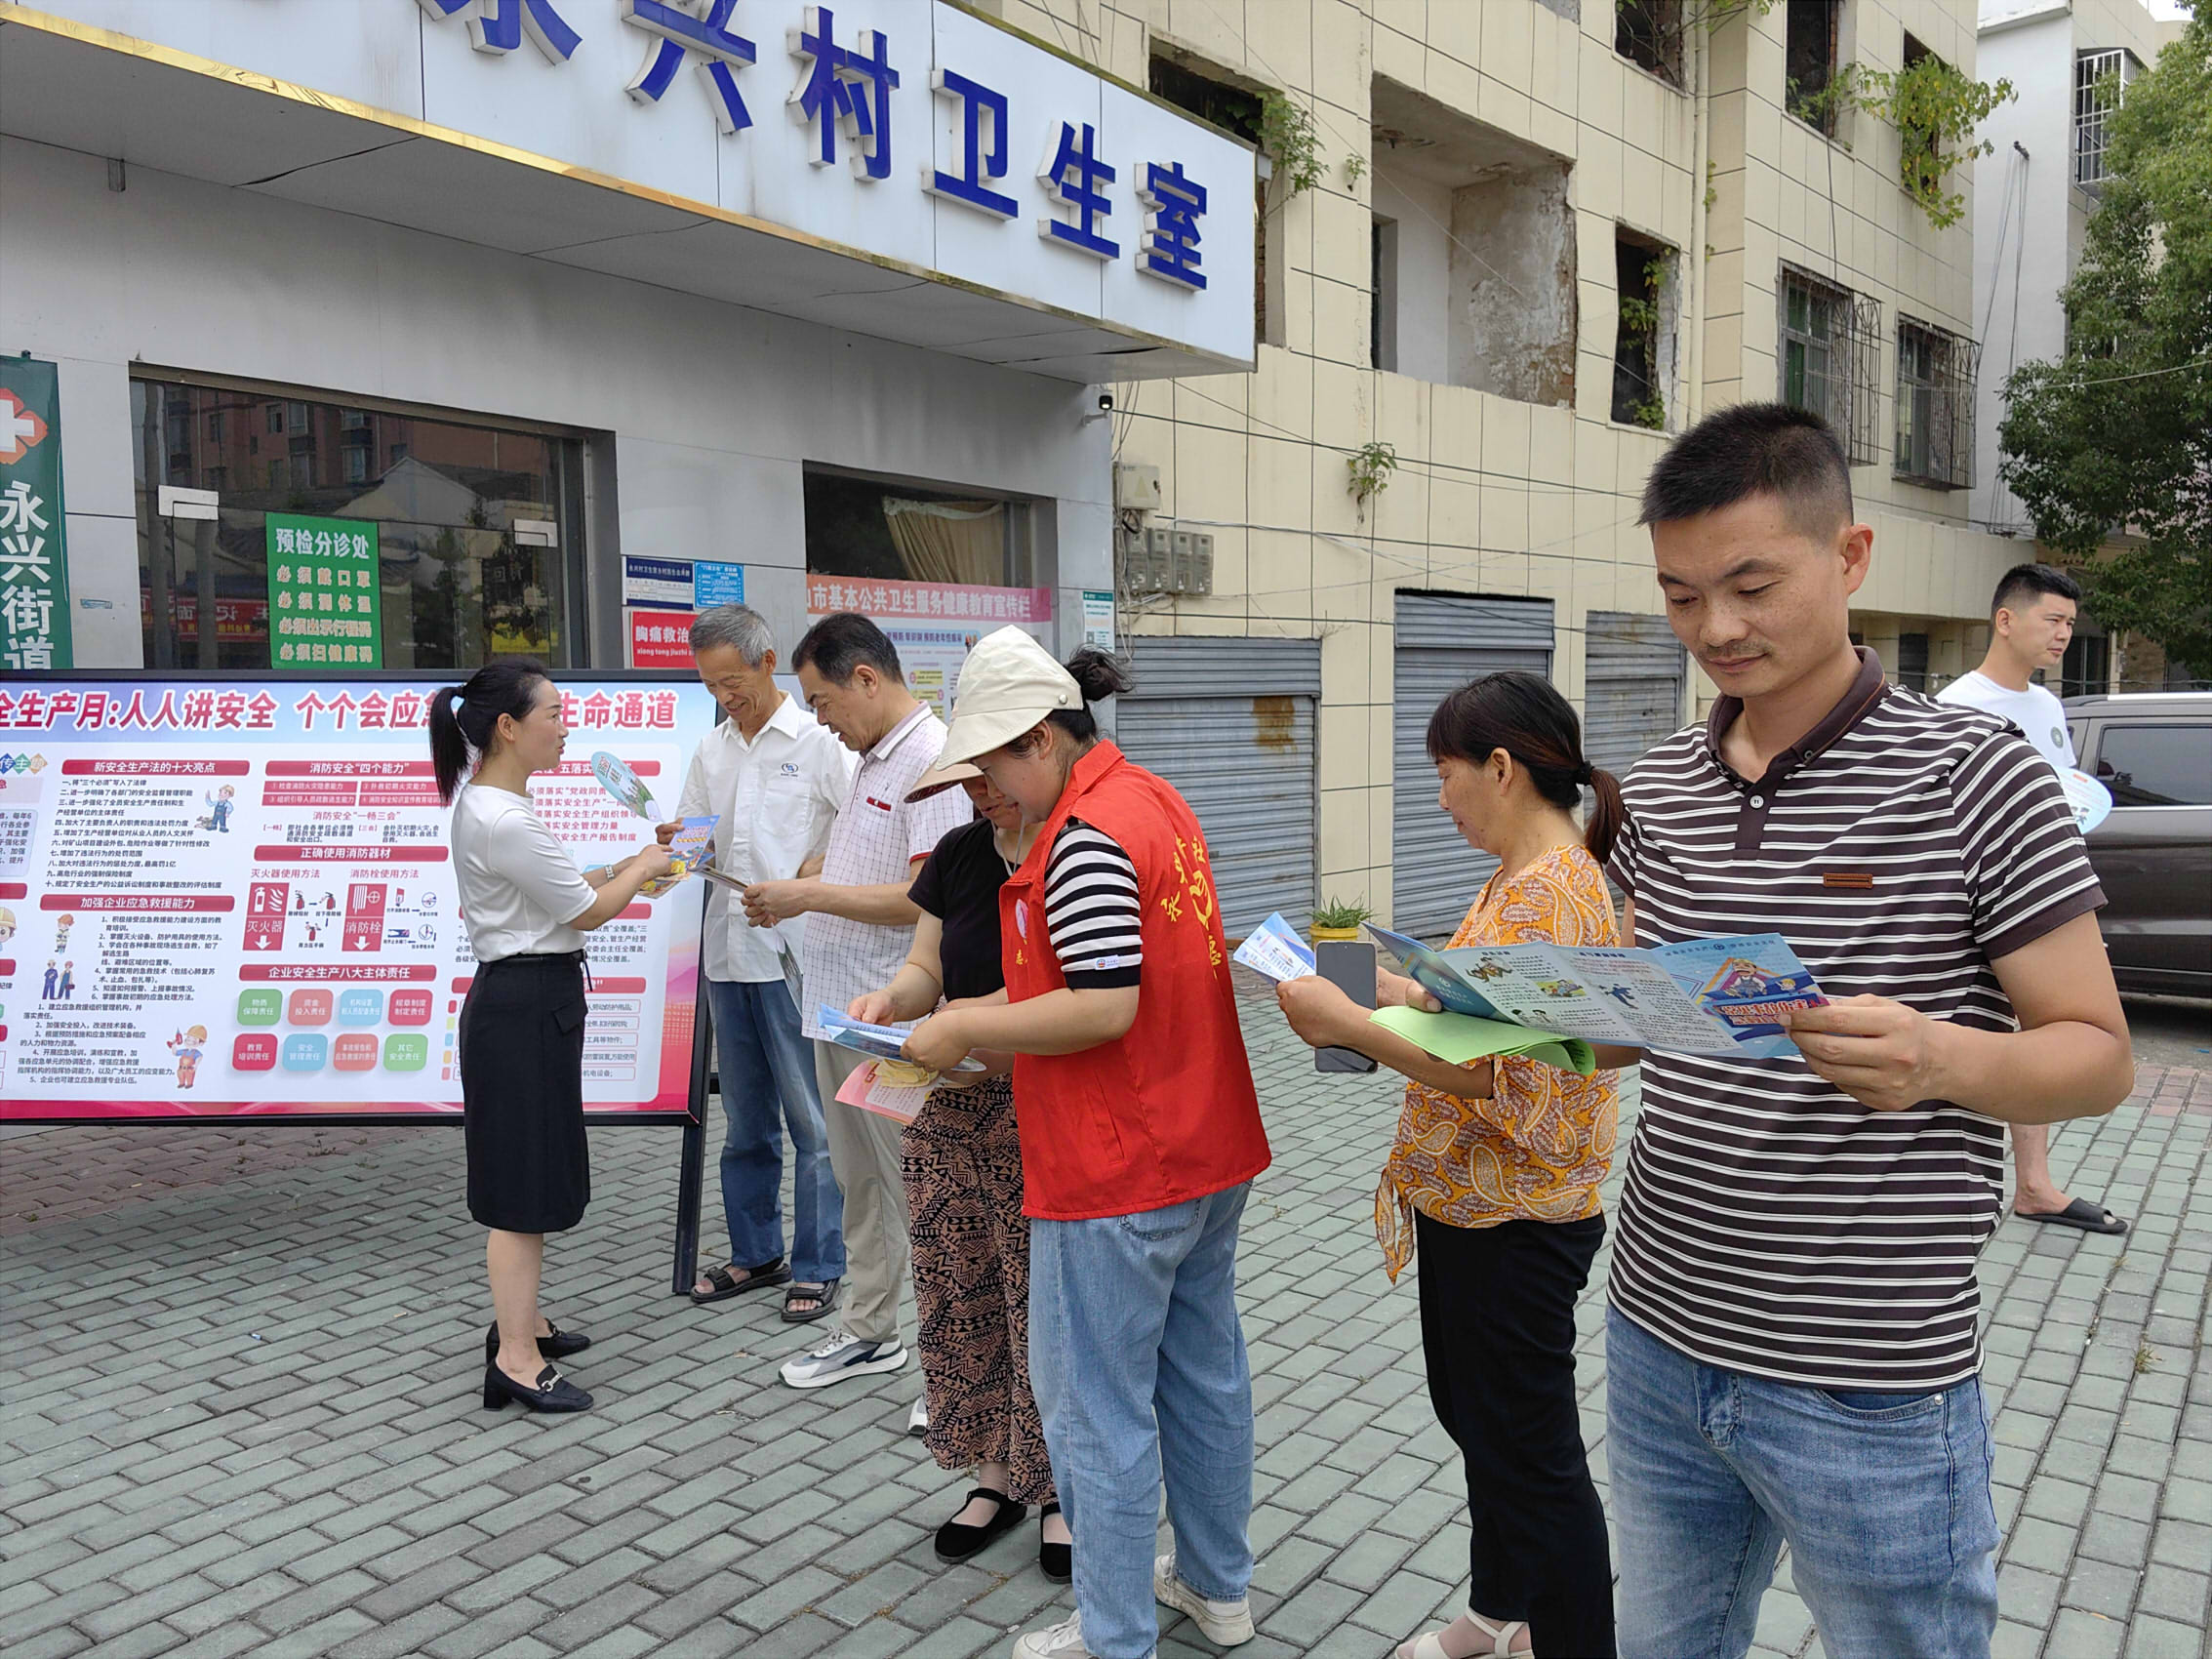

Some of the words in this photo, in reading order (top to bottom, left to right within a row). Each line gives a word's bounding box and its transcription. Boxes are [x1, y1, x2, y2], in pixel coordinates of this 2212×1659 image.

[276, 528, 370, 559] 预检分诊处
[0, 480, 54, 669] 永兴街道
[276, 564, 371, 587] 必须戴口罩
[278, 590, 372, 613] 必须测体温
[279, 616, 372, 638] 必须出示行程码
[635, 626, 689, 644] 胸痛救治
[280, 642, 373, 663] 必须扫健康码
[94, 762, 216, 774] 新安全生产法的十大亮点
[309, 763, 410, 774] 消防安全“四个能力”
[300, 847, 391, 859] 正确使用消防器材
[250, 869, 320, 878] 灭火器使用方法
[350, 869, 420, 878] 消防栓使用方法
[80, 897, 195, 910] 加强企业应急救援能力
[246, 920, 283, 934] 灭火器
[345, 921, 382, 934] 消防栓
[268, 967, 411, 979] 企业安全生产八大主体责任
